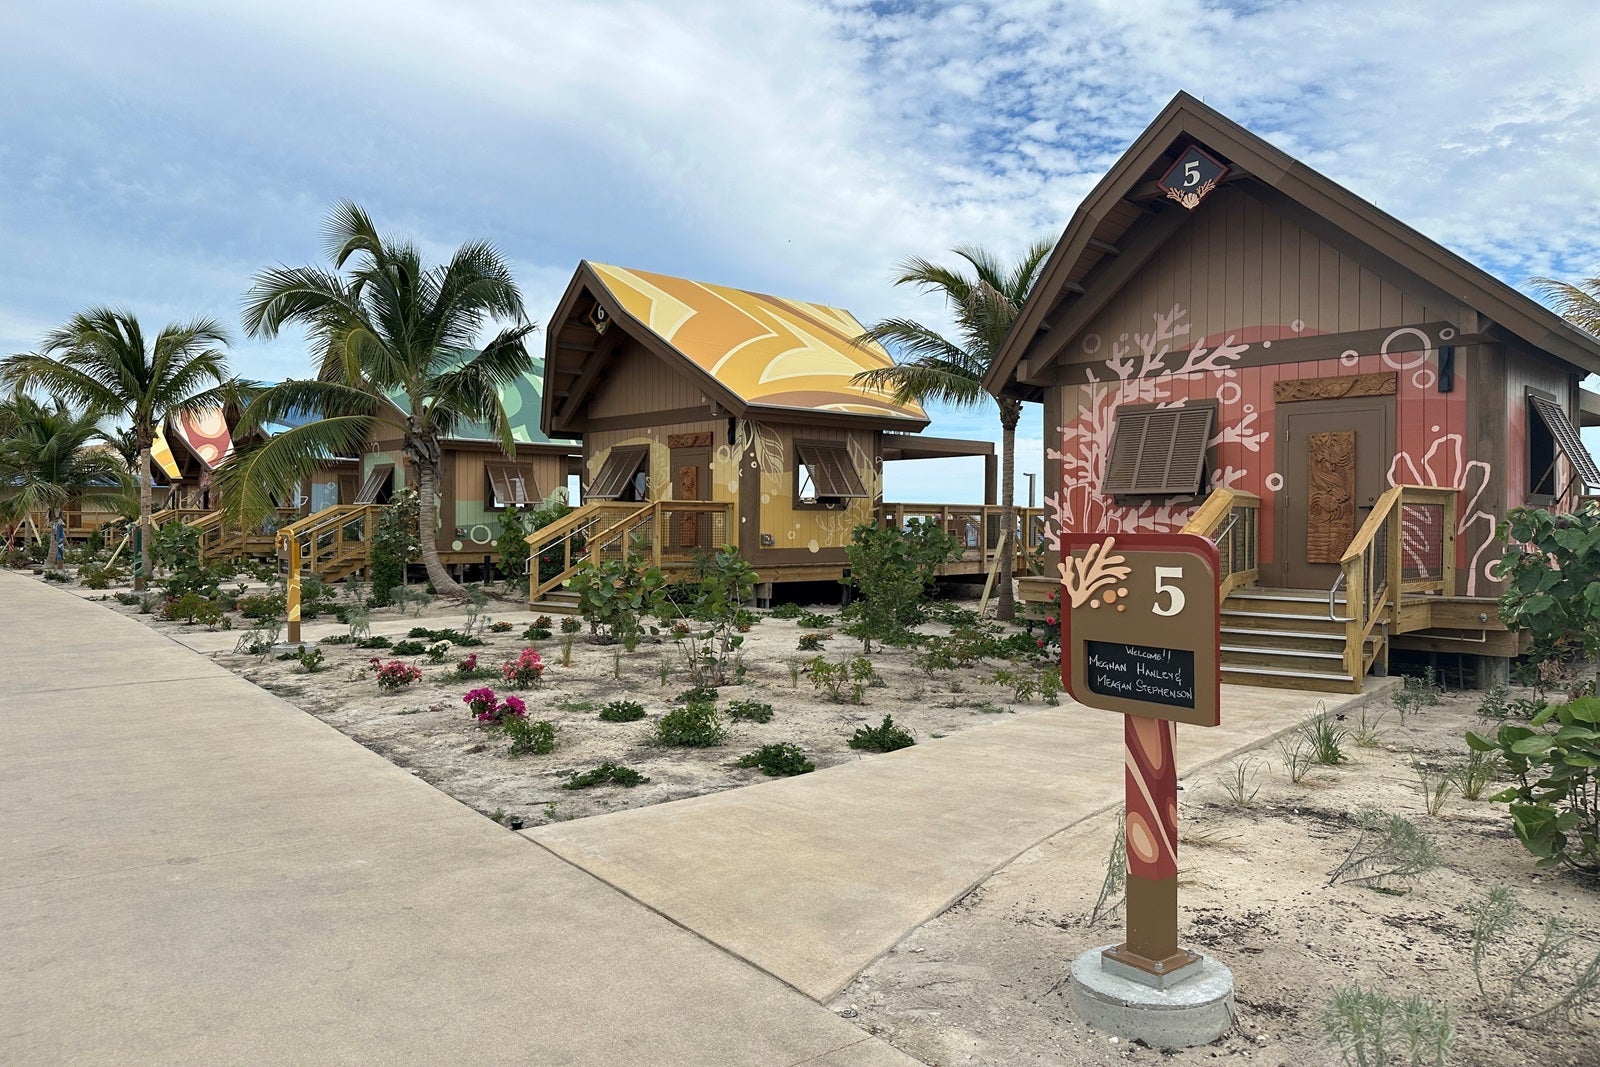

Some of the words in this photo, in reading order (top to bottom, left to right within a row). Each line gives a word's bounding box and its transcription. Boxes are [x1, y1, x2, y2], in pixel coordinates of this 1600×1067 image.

[1183, 160, 1200, 187] 5
[597, 304, 605, 320] 6
[284, 538, 288, 552] 6
[1151, 566, 1186, 617] 5
[1135, 679, 1192, 700] STEPHENSON
